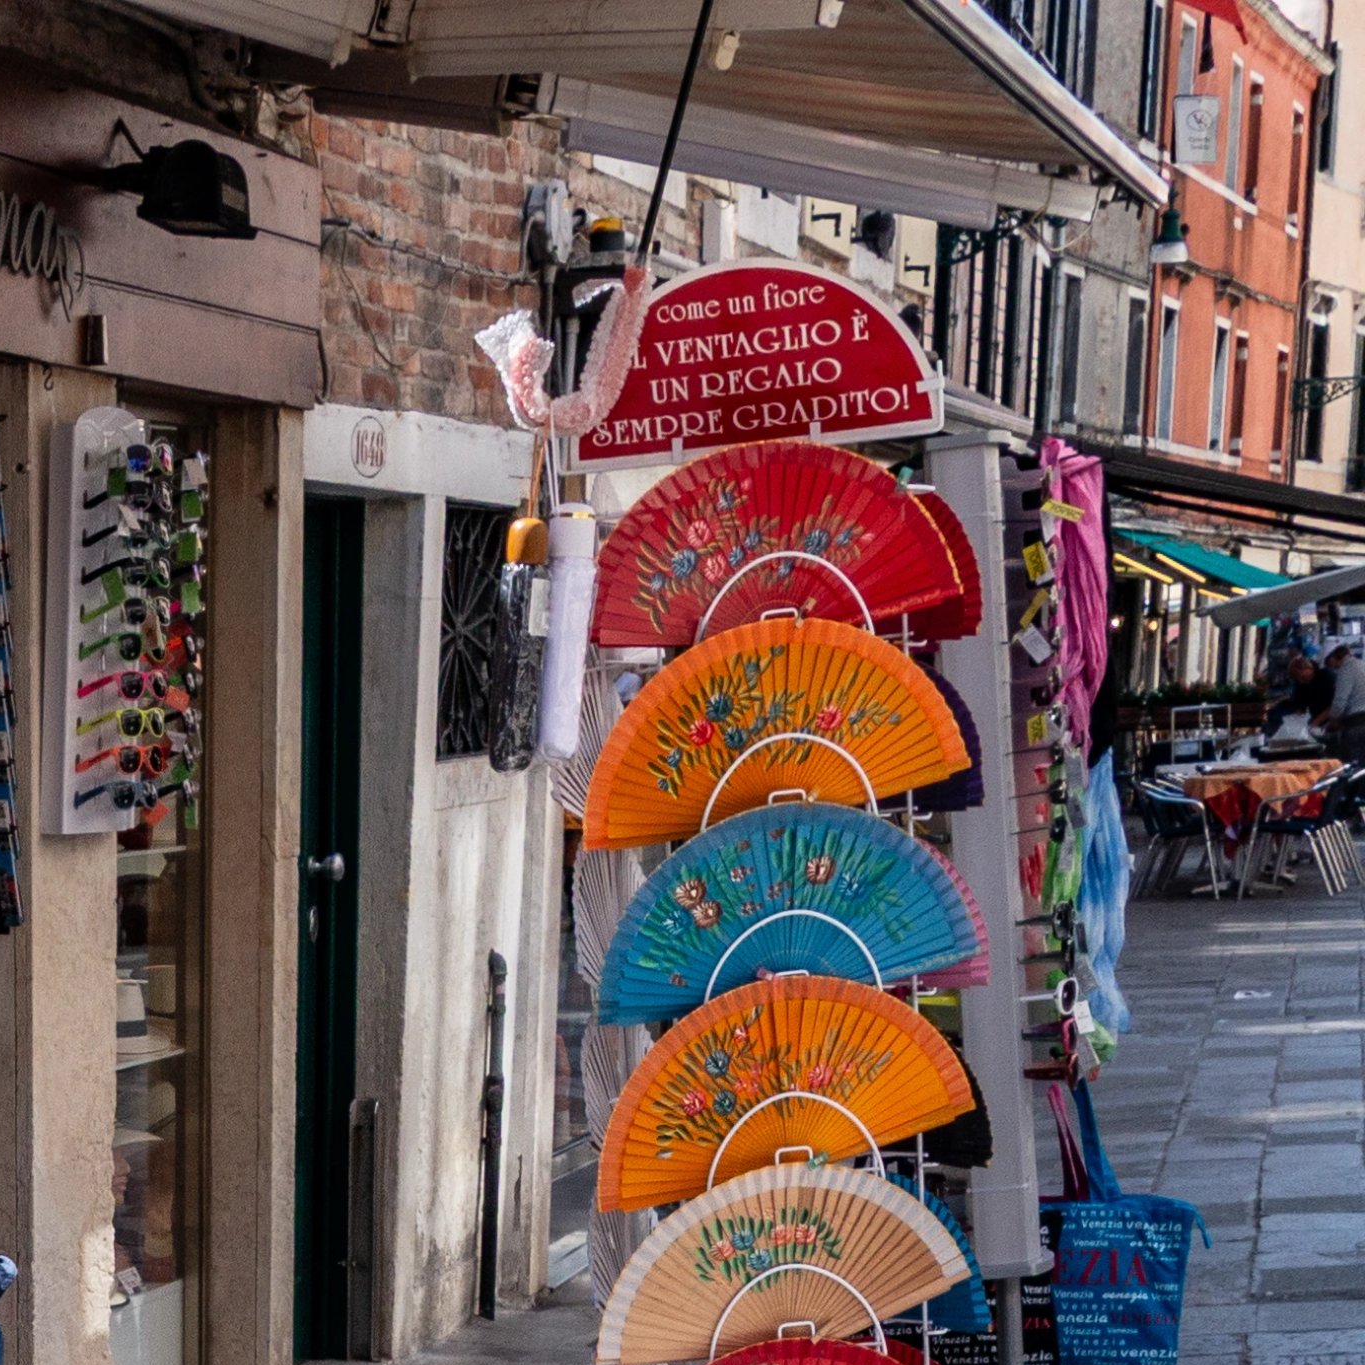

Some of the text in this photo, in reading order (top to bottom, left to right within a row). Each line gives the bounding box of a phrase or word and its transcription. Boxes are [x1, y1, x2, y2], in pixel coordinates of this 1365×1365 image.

[656, 282, 826, 324] come un fiore
[653, 318, 842, 367] VENTAGLIO
[850, 308, 870, 342] È
[648, 357, 842, 405] UN REGALO
[591, 383, 910, 447] SEMPRE GRADITO!
[355, 429, 384, 467] 1648
[1080, 1218, 1182, 1232] Venezia venezia
[1053, 1289, 1094, 1299] Venezia
[943, 1355, 990, 1365] Venezia
[1073, 1347, 1118, 1358] Venezia
